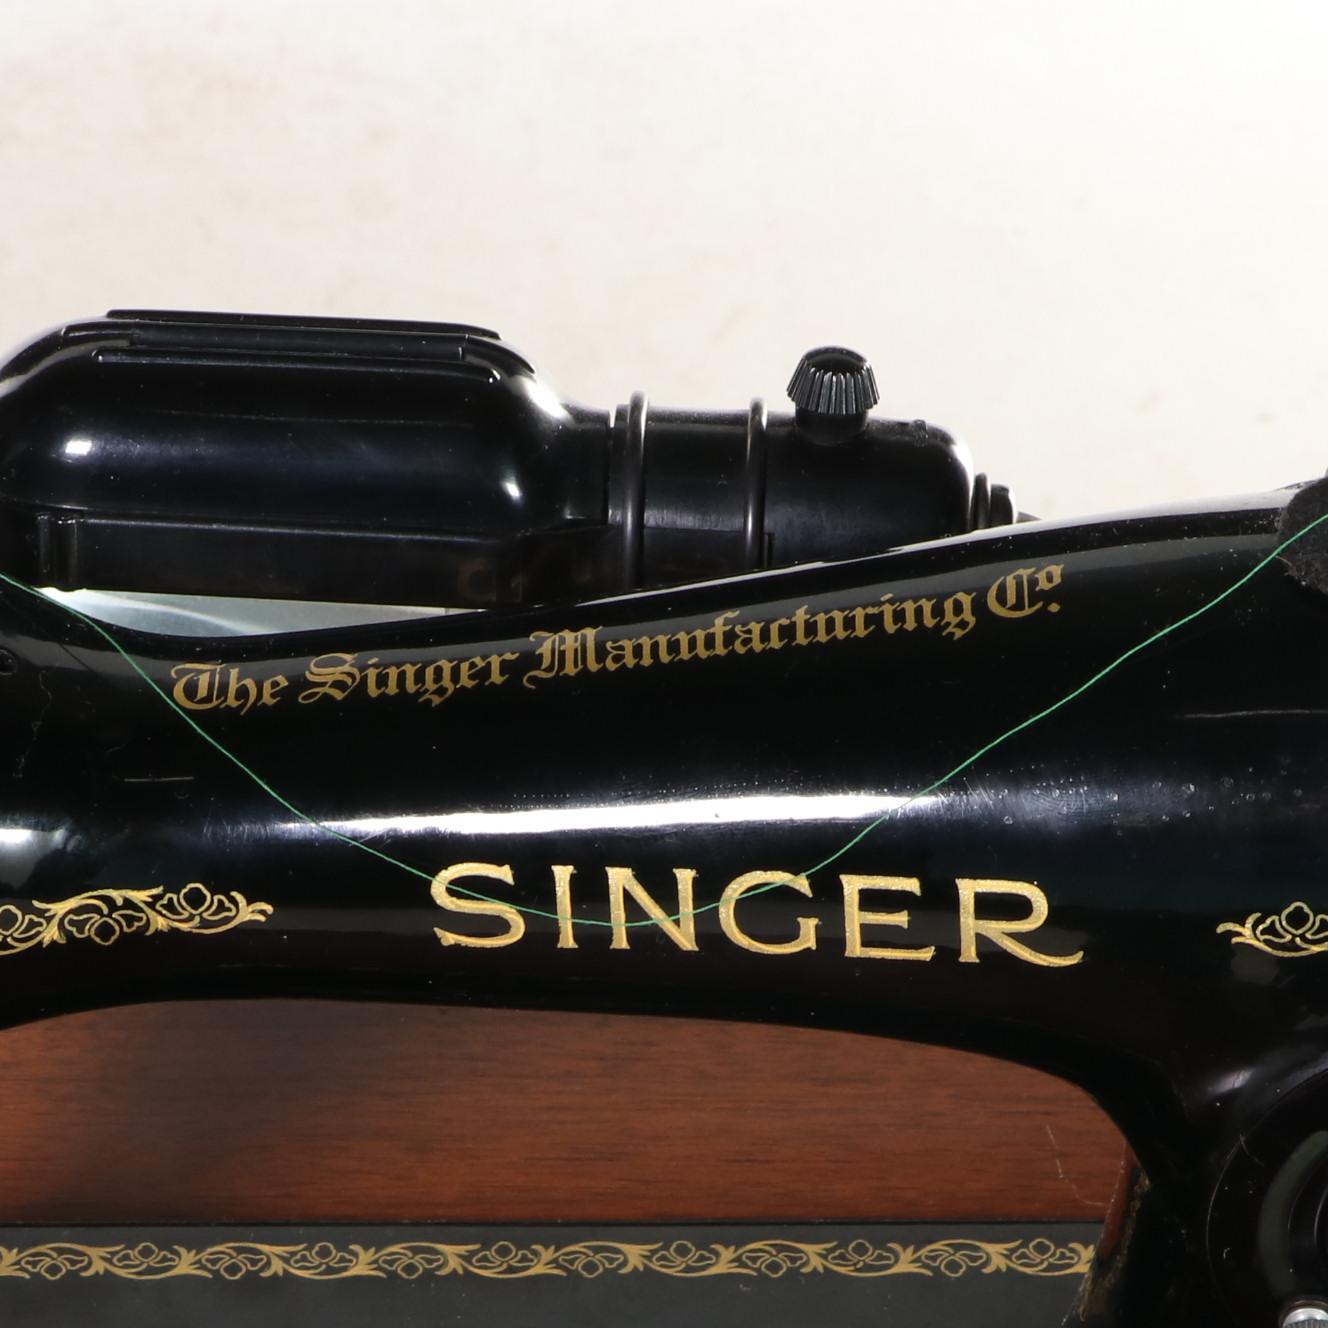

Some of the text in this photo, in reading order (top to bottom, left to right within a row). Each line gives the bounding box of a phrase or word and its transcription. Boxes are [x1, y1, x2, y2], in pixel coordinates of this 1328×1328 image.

[170, 661, 289, 716] The
[298, 651, 520, 707] Singer
[524, 592, 977, 689] Manufacturing
[429, 862, 1084, 967] SINGER
